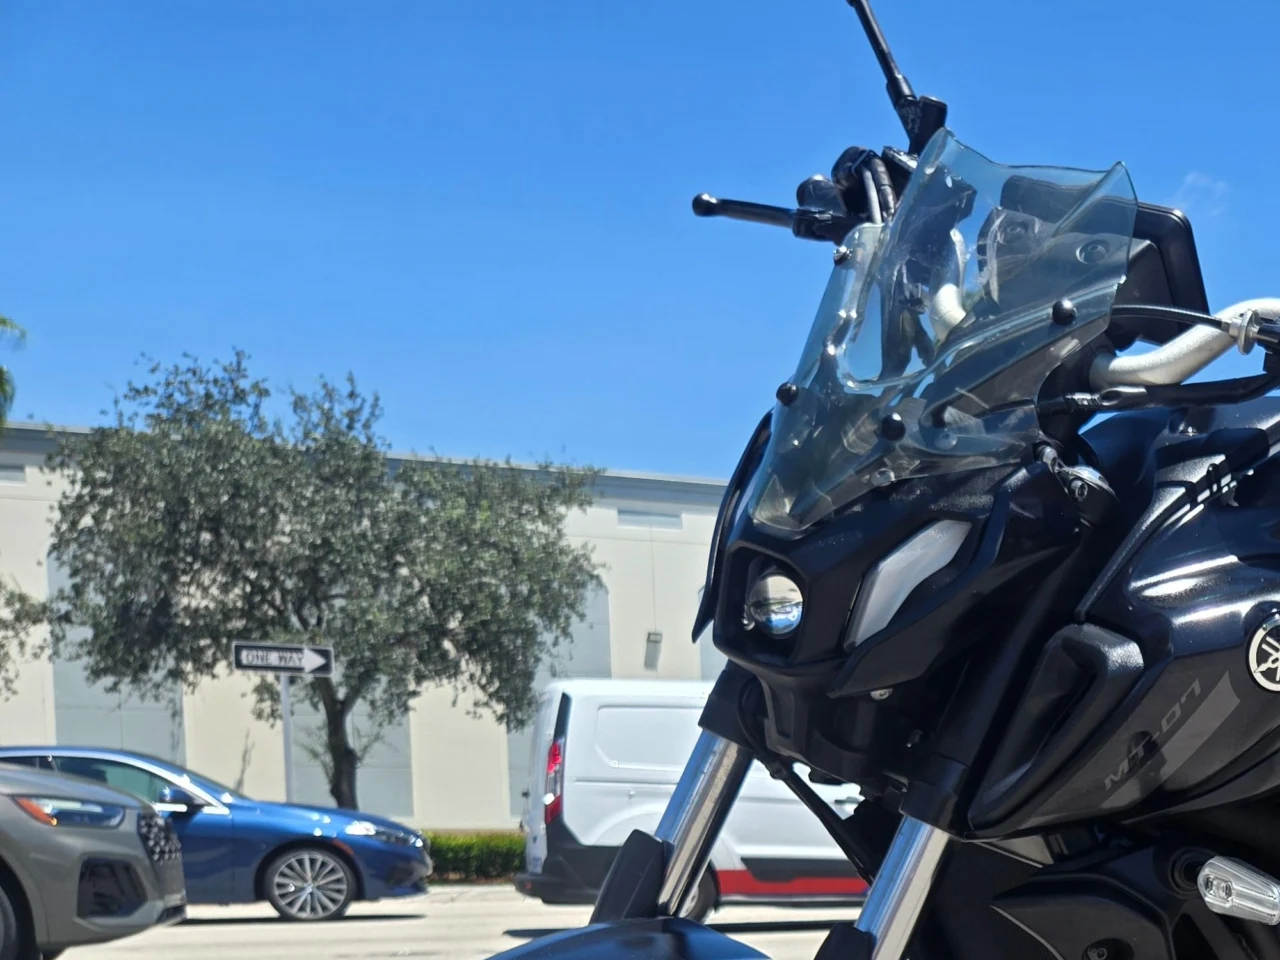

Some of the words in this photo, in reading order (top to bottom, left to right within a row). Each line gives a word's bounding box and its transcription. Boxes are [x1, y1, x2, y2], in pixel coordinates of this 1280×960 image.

[245, 650, 272, 666] ONE
[277, 652, 304, 668] WAY
[1104, 678, 1202, 791] MT-07
